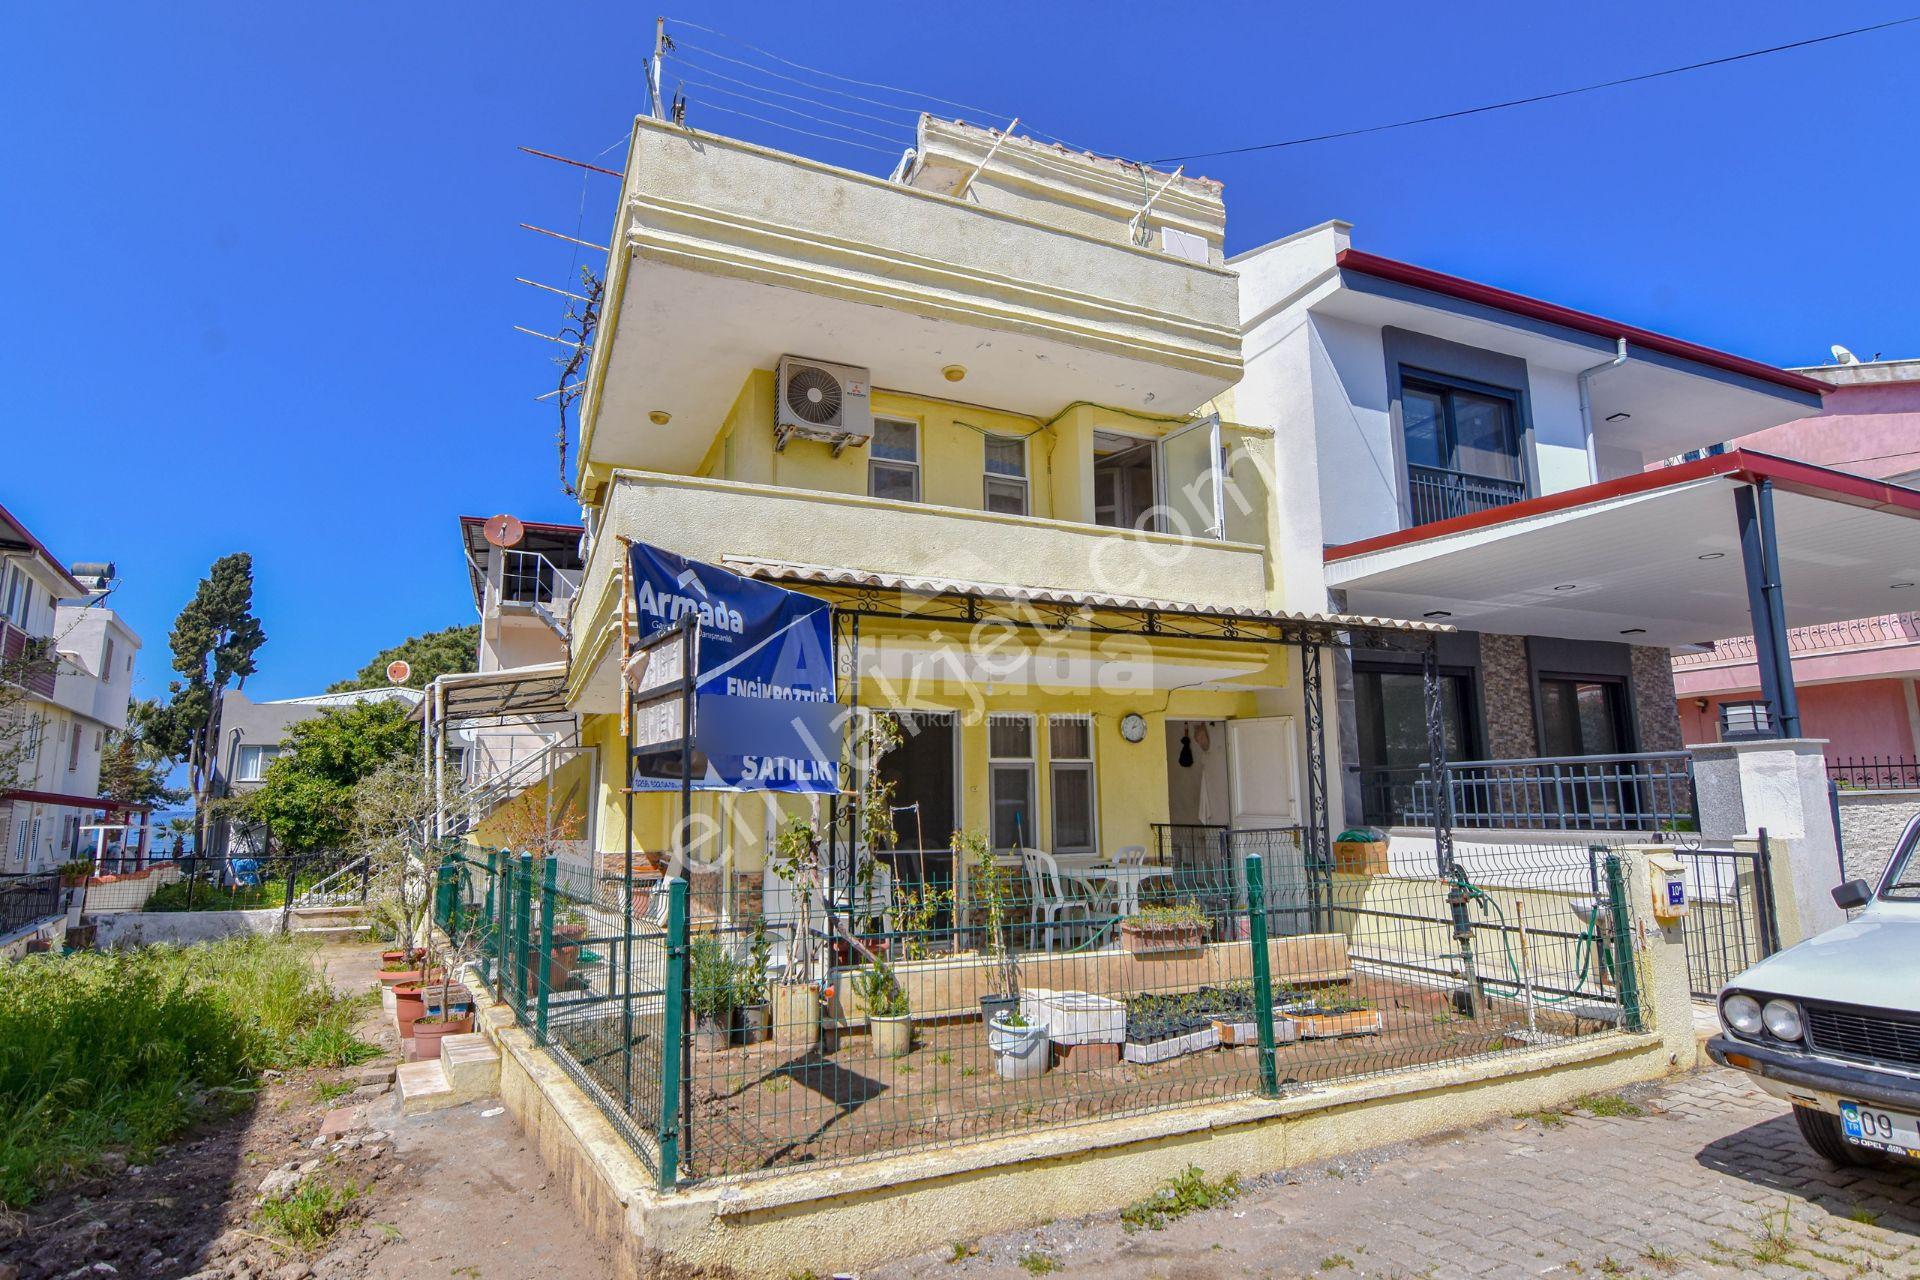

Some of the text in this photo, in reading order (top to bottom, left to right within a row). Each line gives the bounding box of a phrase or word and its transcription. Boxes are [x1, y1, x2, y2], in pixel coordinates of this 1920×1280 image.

[639, 580, 744, 634] Armada
[741, 755, 833, 781] SATILIK
[1848, 1112, 1893, 1139] TR 09
[1860, 1139, 1885, 1150] OPEL
